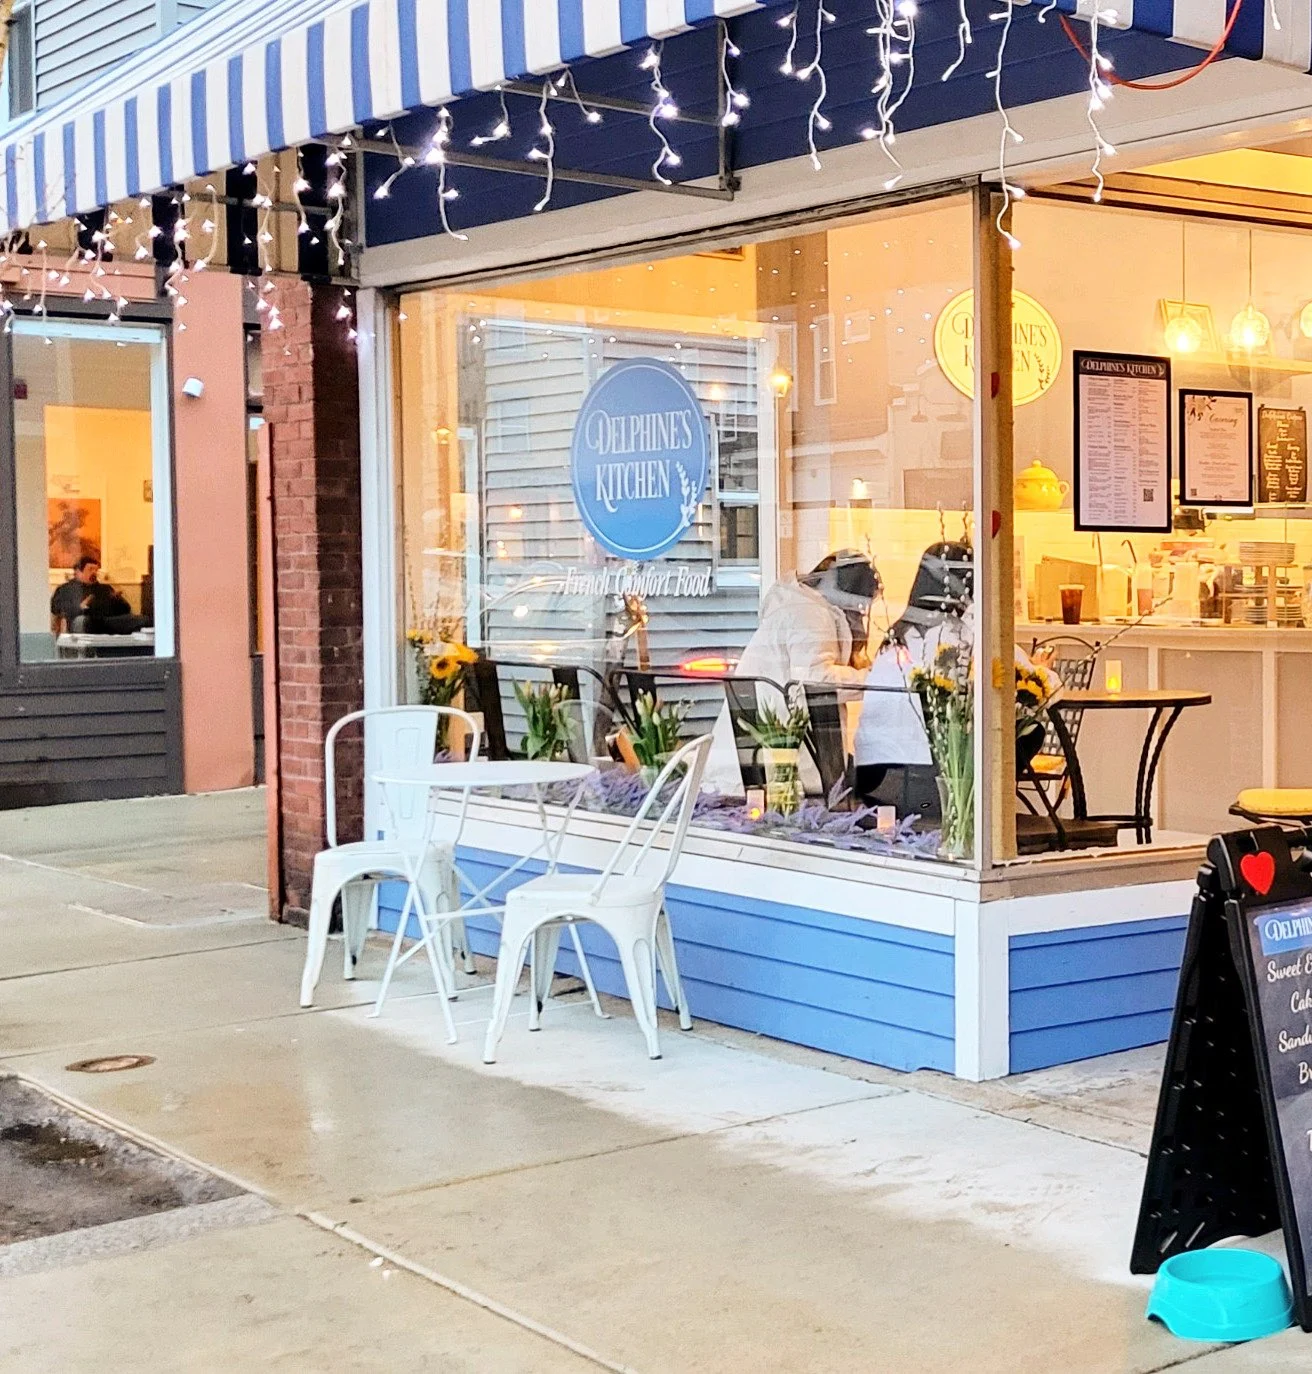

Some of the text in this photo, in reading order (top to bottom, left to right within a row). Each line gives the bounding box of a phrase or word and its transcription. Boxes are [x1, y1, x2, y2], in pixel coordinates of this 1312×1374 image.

[1127, 364, 1156, 376] KITCHEN
[585, 409, 692, 456] DELPHINE'S
[596, 459, 671, 512] KITCHEN
[563, 566, 712, 600] French Comfort Food
[1267, 958, 1302, 982] Sweet
